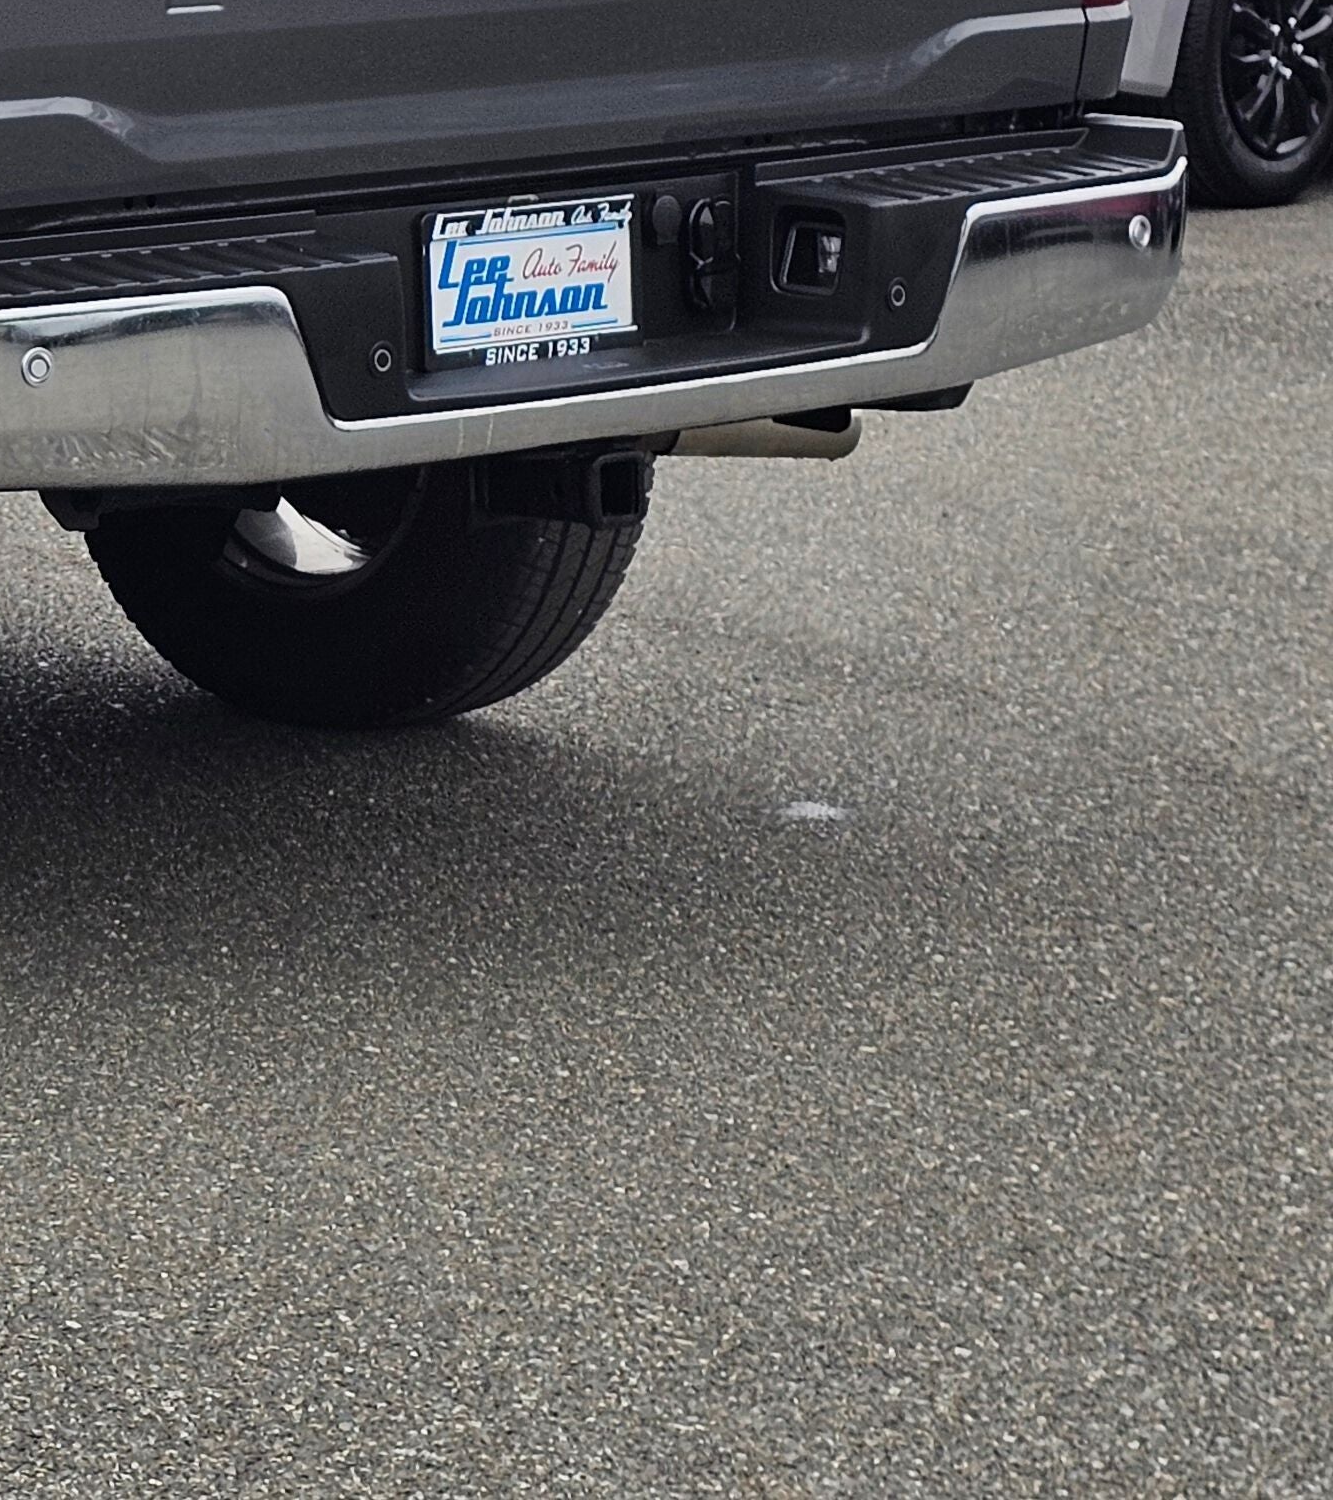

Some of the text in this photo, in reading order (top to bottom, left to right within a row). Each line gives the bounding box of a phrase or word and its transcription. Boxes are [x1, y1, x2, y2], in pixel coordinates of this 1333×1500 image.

[475, 207, 566, 235] Johnson
[438, 240, 619, 290] Lee Auto Family
[442, 275, 608, 327] Johnson
[493, 320, 569, 337] SINCE 1933
[485, 337, 591, 366] SINCE 1933
